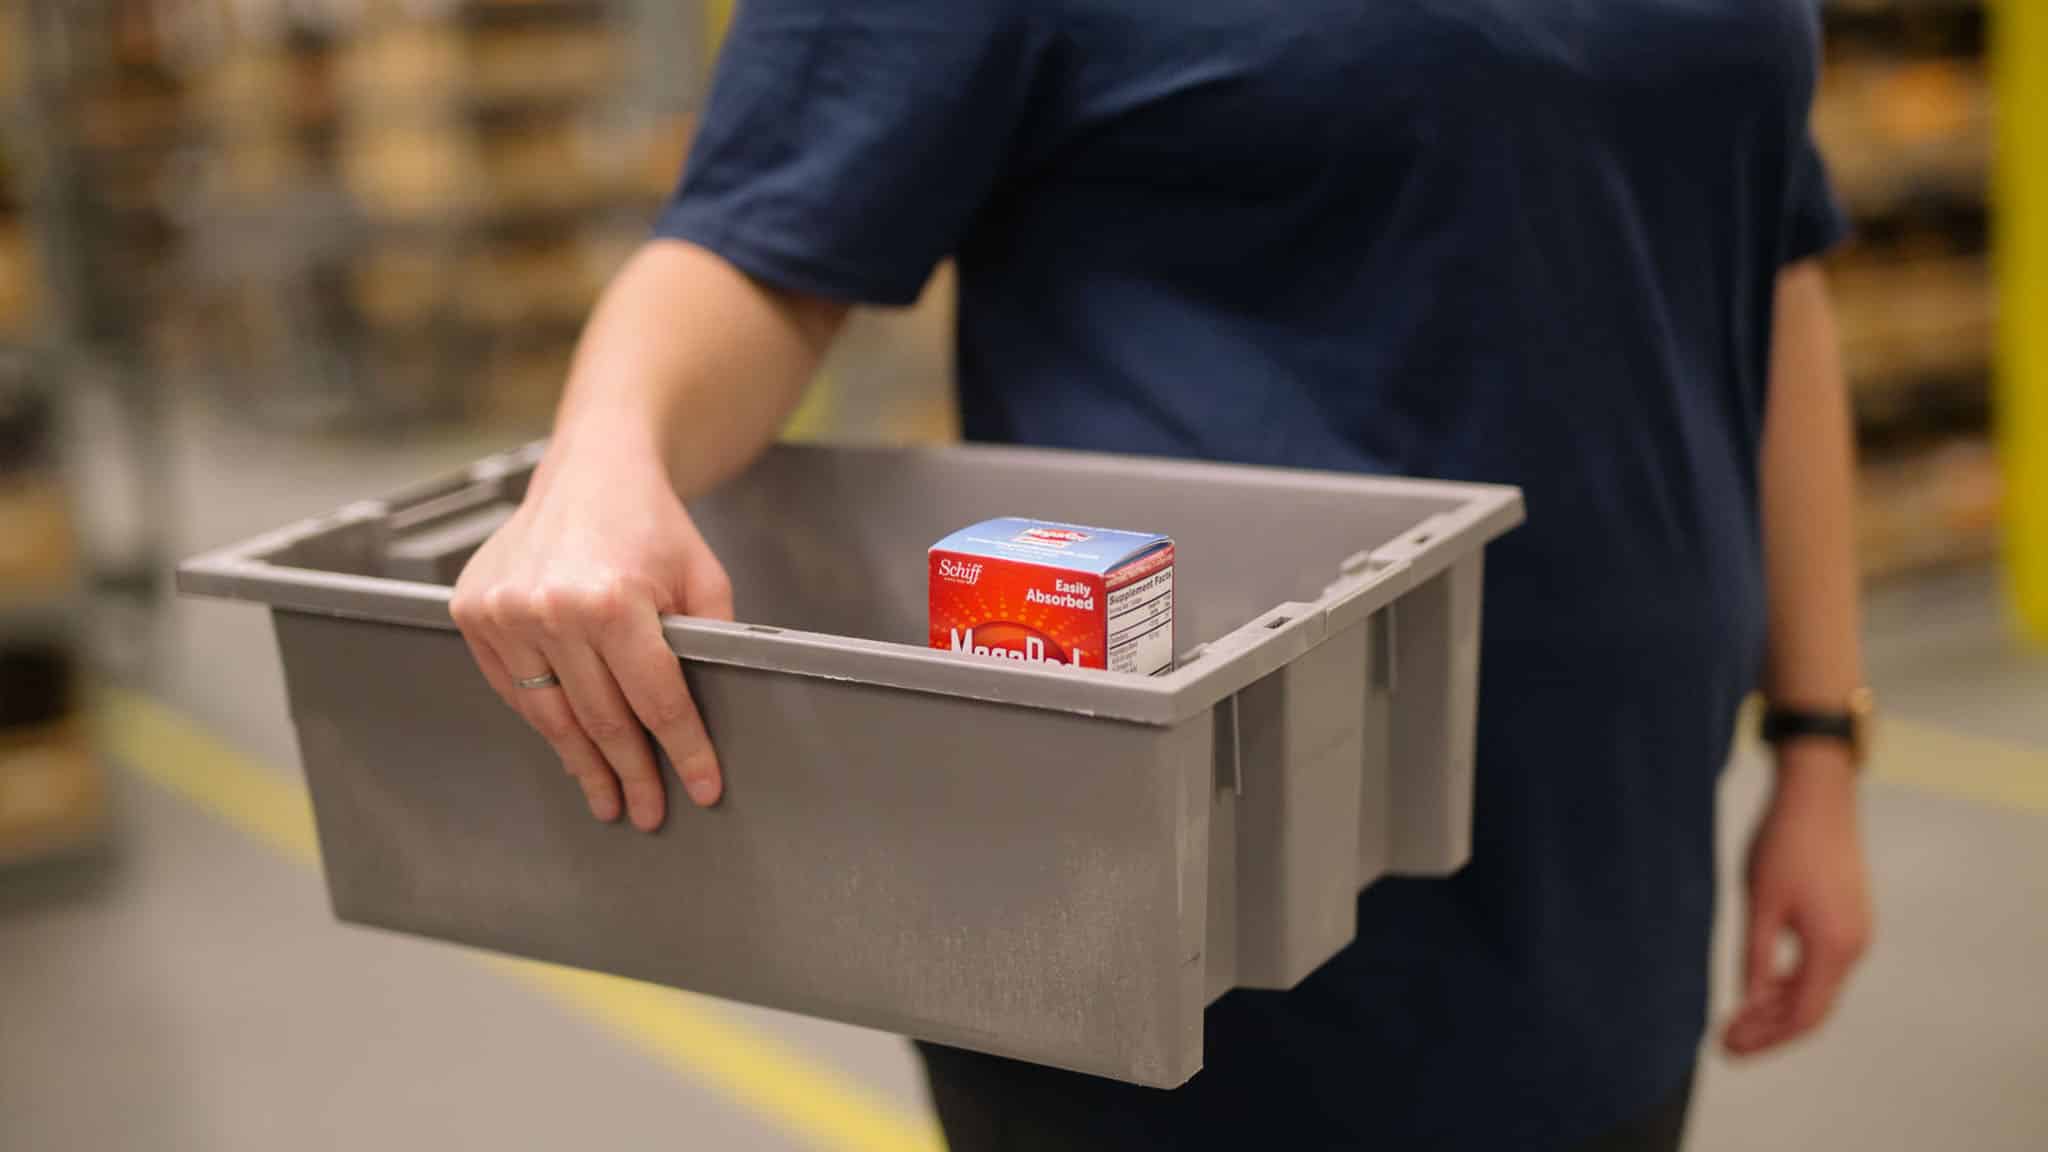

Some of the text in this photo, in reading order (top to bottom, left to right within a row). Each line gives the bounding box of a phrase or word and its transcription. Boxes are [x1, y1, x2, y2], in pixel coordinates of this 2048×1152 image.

[938, 558, 983, 585] Schiff
[1056, 579, 1091, 597] Easily
[1026, 589, 1094, 611] Absorbed
